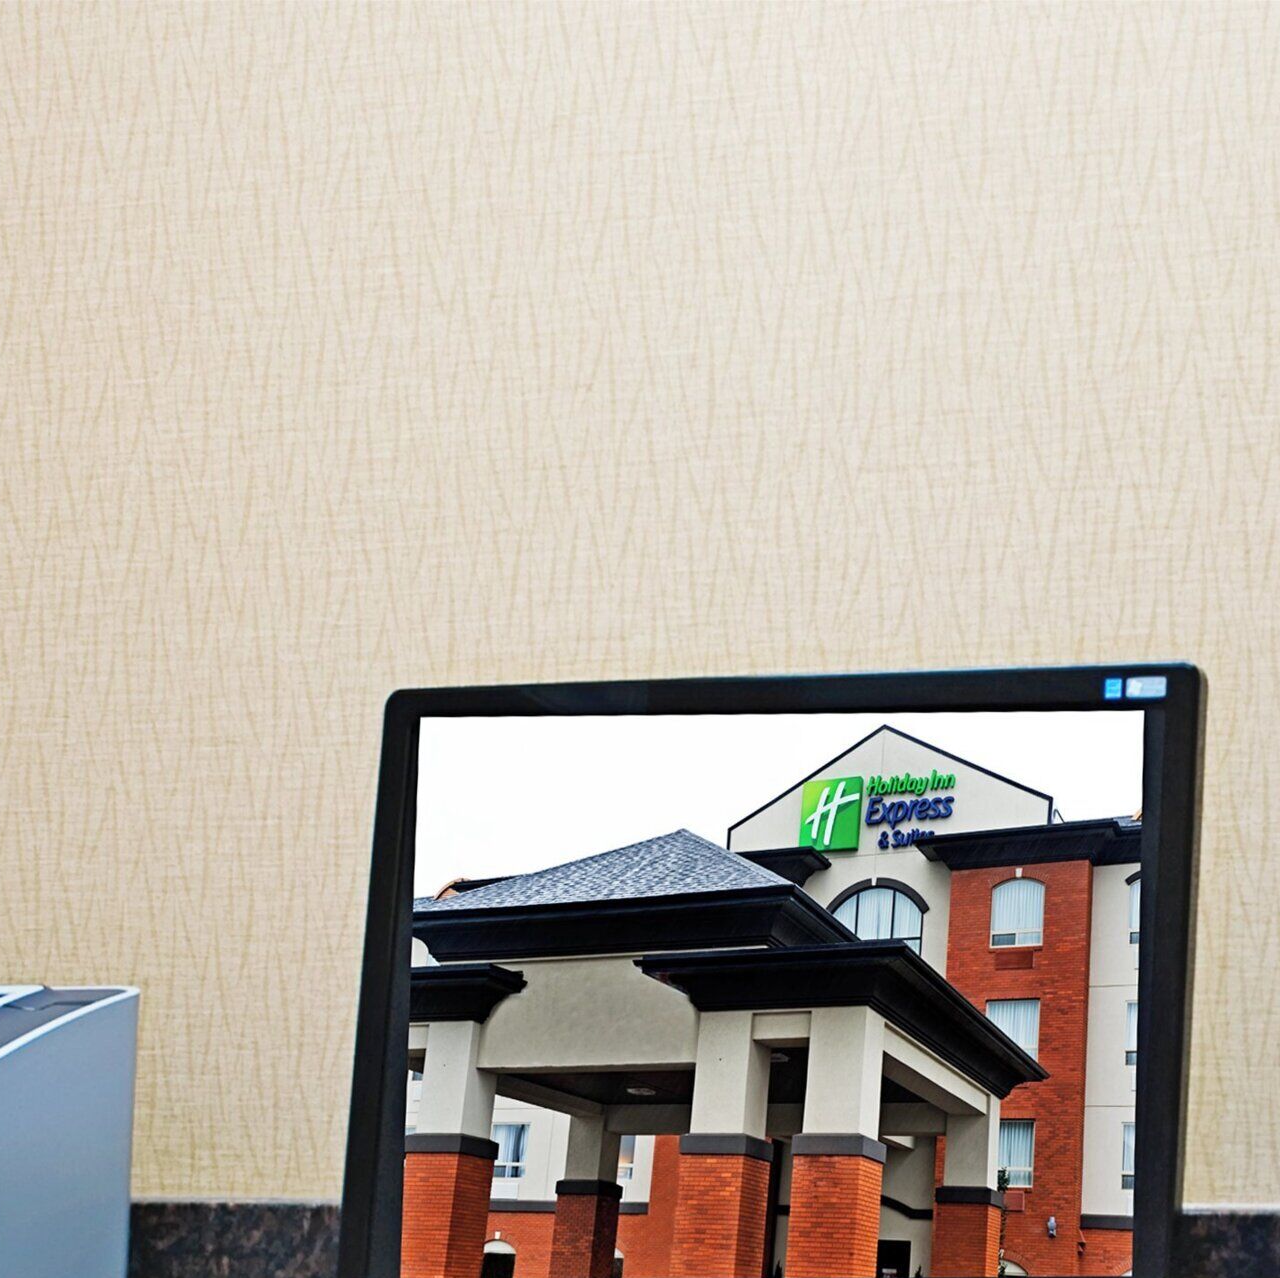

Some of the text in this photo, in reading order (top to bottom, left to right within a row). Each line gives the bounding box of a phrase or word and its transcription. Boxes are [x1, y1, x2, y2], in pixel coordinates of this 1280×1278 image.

[867, 769, 956, 797] Holiday Inn
[864, 796, 955, 830] Express
[877, 830, 890, 850] &
